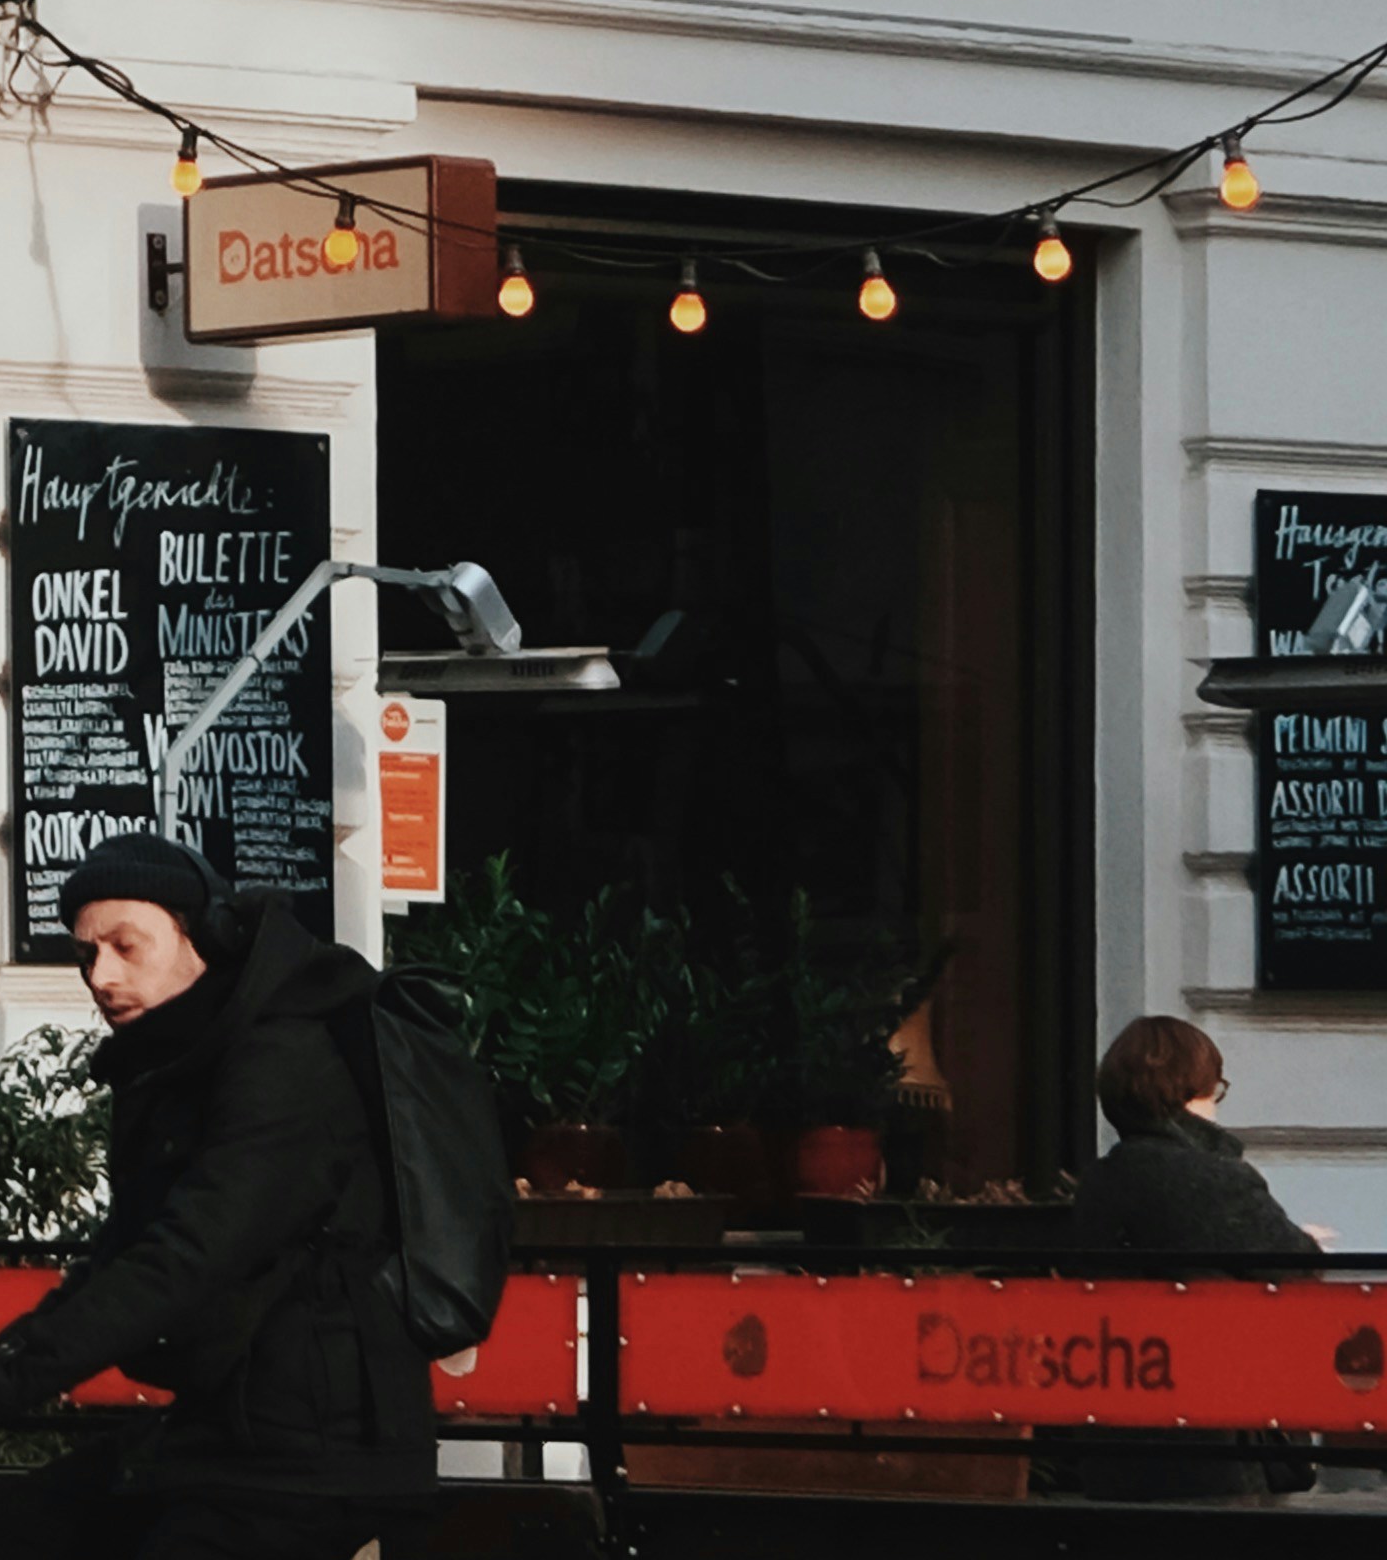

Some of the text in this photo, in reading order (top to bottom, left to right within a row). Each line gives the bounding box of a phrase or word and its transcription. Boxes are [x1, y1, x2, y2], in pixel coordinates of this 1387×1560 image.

[158, 531, 293, 586] BULETTE
[32, 569, 128, 622] ONKEL
[35, 623, 129, 678] DAVID
[1271, 779, 1364, 819] ASSORTI
[1273, 863, 1375, 905] ASSORTI
[917, 1312, 1176, 1391] Datscha
